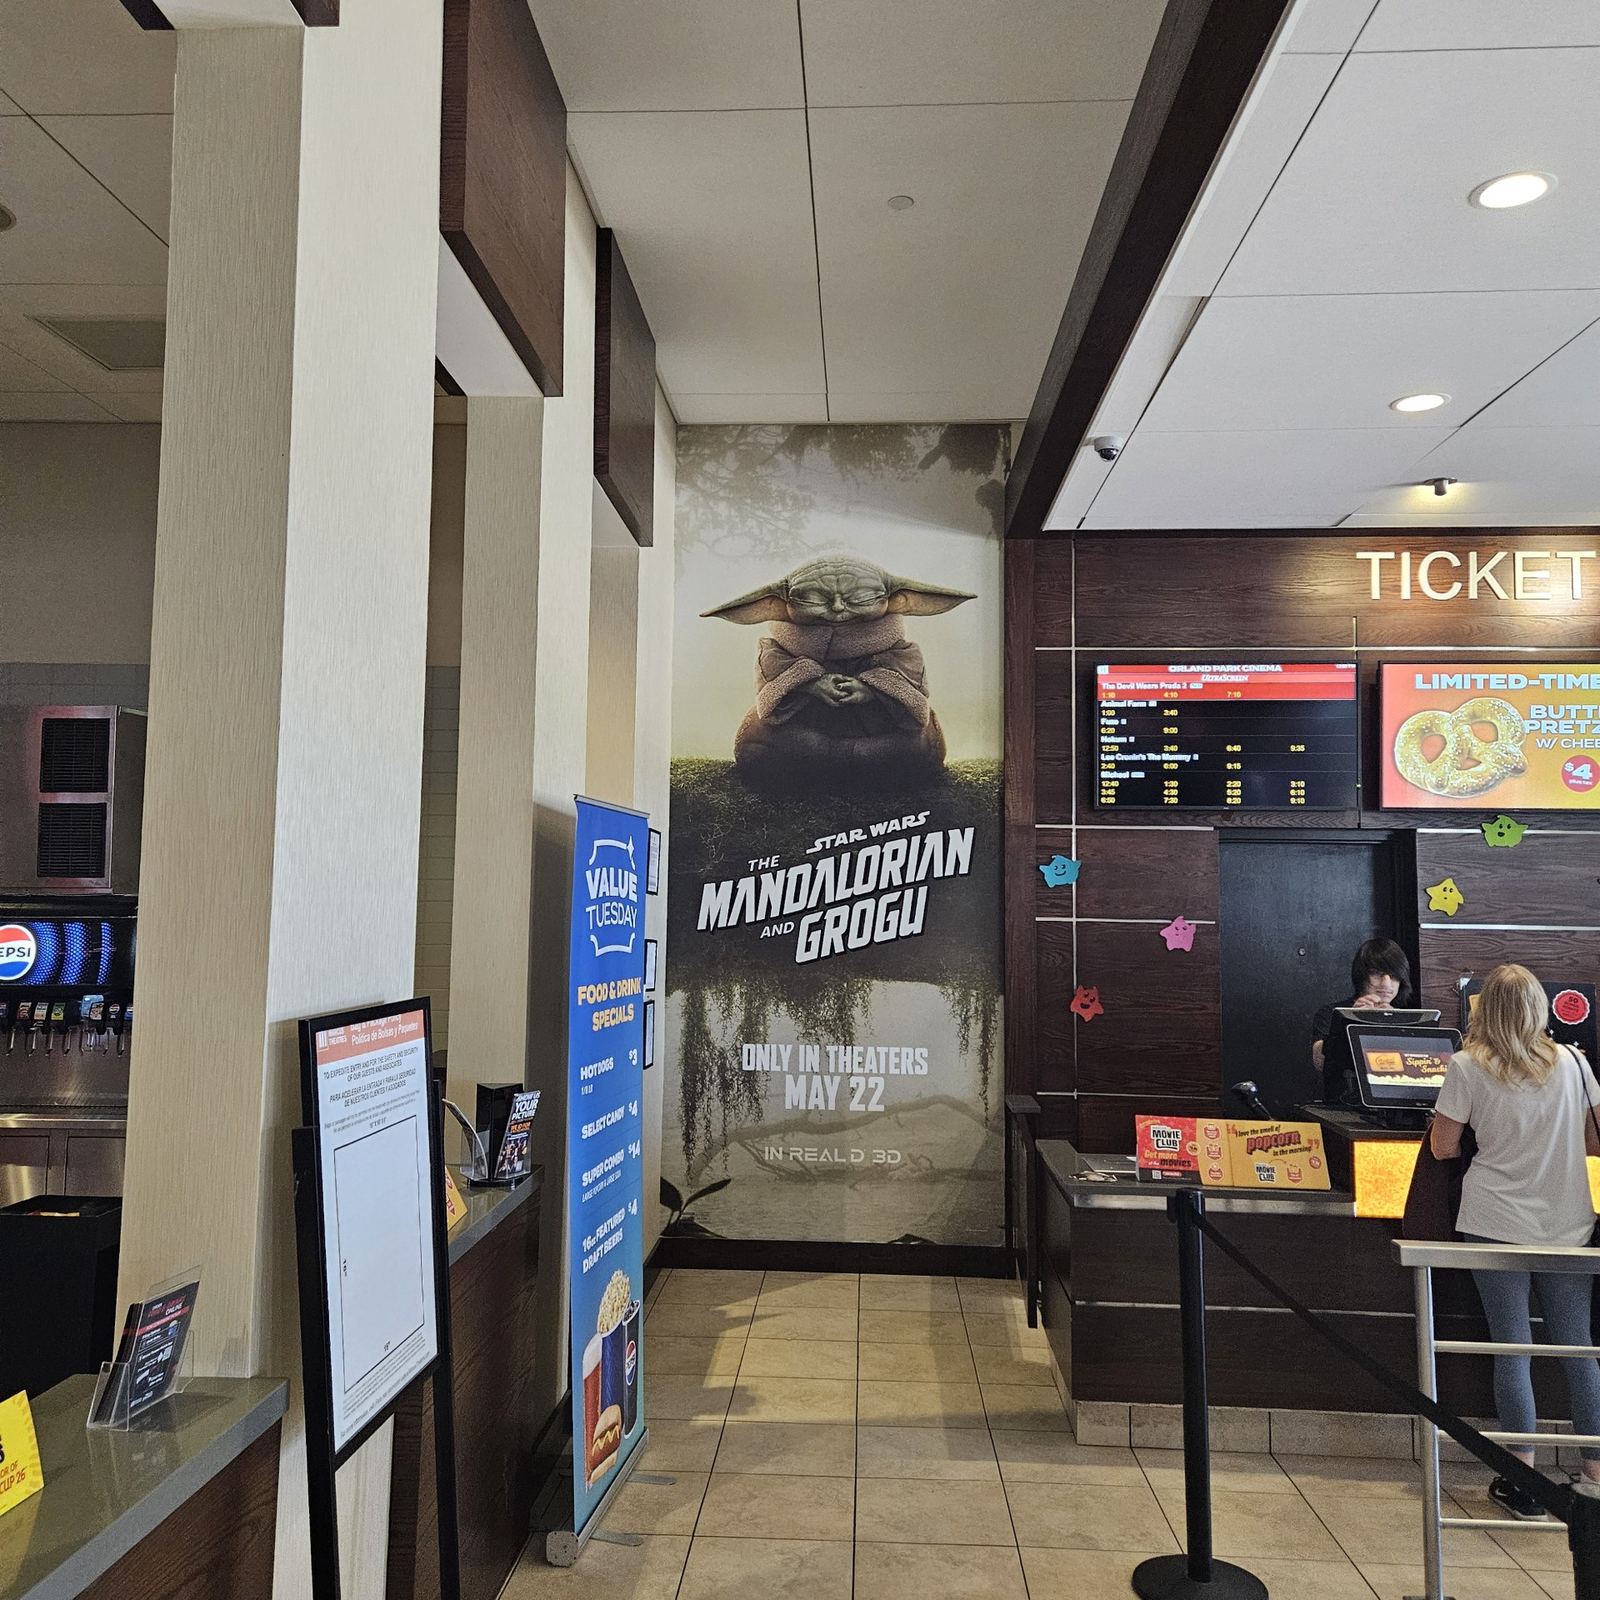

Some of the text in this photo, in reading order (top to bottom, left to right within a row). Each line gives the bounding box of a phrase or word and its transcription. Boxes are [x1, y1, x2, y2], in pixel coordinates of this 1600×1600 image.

[1355, 551, 1597, 601] TICKET
[1168, 664, 1283, 672] ORLAND PARK CINEMA
[1415, 674, 1600, 690] LIMITED-TIME
[1530, 705, 1600, 720] BUTT
[1524, 720, 1600, 734] PRETZ
[1536, 739, 1558, 750] W/
[1564, 762, 1593, 780] $4
[806, 810, 931, 854] STAR WARS
[748, 854, 780, 872] THE
[586, 867, 638, 903] VALUE
[697, 827, 975, 931] MANDALORIAN
[586, 902, 638, 930] TUESDAY
[796, 885, 928, 963] GROGU
[760, 921, 795, 939] AND
[578, 977, 642, 1006] FOOD & DRINK
[592, 1003, 635, 1032] SPECIALS
[378, 1028, 394, 1040] Bolsas
[580, 1048, 638, 1081] HOT DOGS $3
[742, 1044, 929, 1075] ONLY IN THEATERS
[1406, 1057, 1432, 1068] Sippin'
[785, 1074, 885, 1112] MAY 22
[516, 1099, 539, 1113] YOUR
[512, 1110, 535, 1121] PICTURE
[582, 1100, 638, 1140] SELECT CANDY $4
[1152, 1130, 1181, 1139] MOVIE
[1238, 1129, 1250, 1137] love
[1260, 1126, 1274, 1134] smell
[1275, 1124, 1281, 1133] of
[1156, 1139, 1178, 1150] CLUB
[1247, 1131, 1301, 1155] popcorn
[582, 1139, 641, 1187] SUPER COMBO $14
[764, 1146, 783, 1160] IN
[872, 1149, 901, 1164] 3D
[1144, 1150, 1157, 1159] Get
[1160, 1159, 1192, 1167] movies
[1256, 1166, 1276, 1174] MOVIE
[1259, 1174, 1275, 1182] CLUB
[596, 1208, 626, 1242] FEATURED
[628, 1198, 638, 1216] $4
[582, 1228, 623, 1274] DRAFT BEERS
